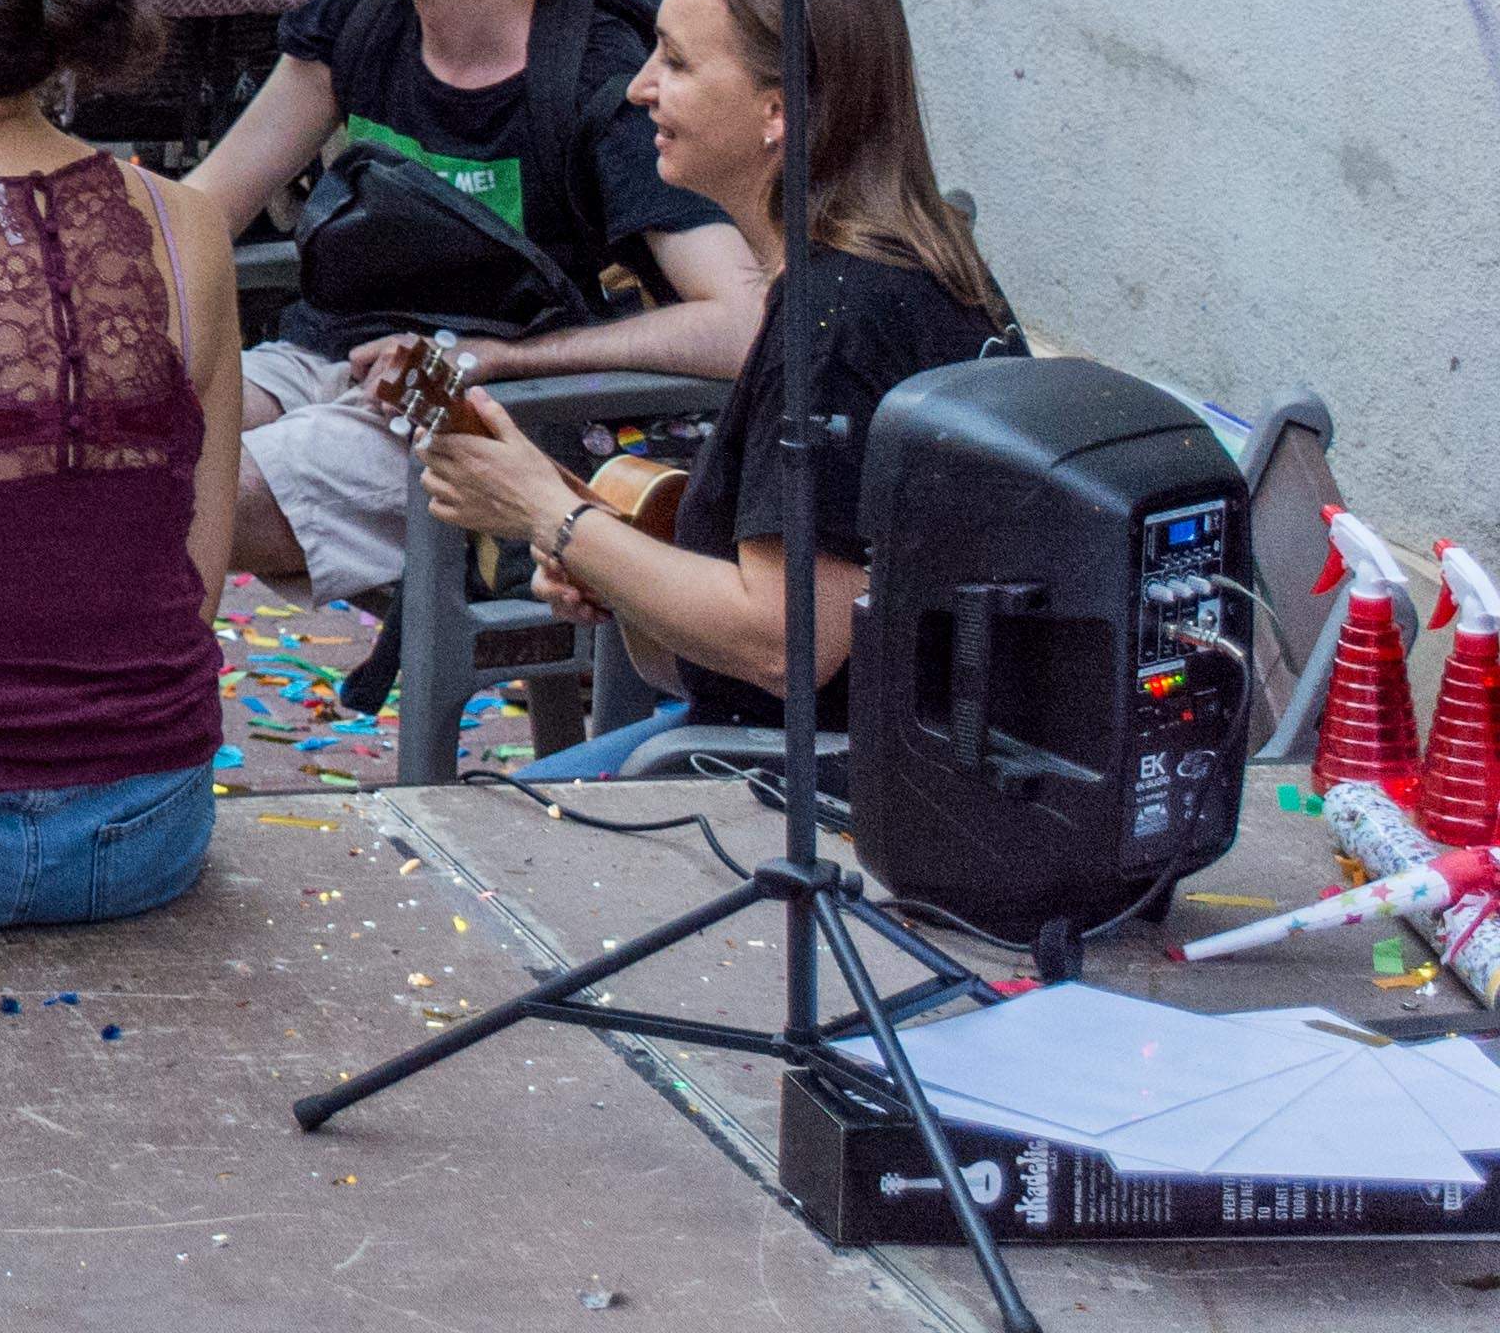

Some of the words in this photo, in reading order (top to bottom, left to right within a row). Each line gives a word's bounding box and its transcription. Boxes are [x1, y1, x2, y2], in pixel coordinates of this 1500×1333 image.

[454, 169, 496, 194] ME!
[1140, 751, 1167, 779] EK
[1257, 1206, 1272, 1221] TO
